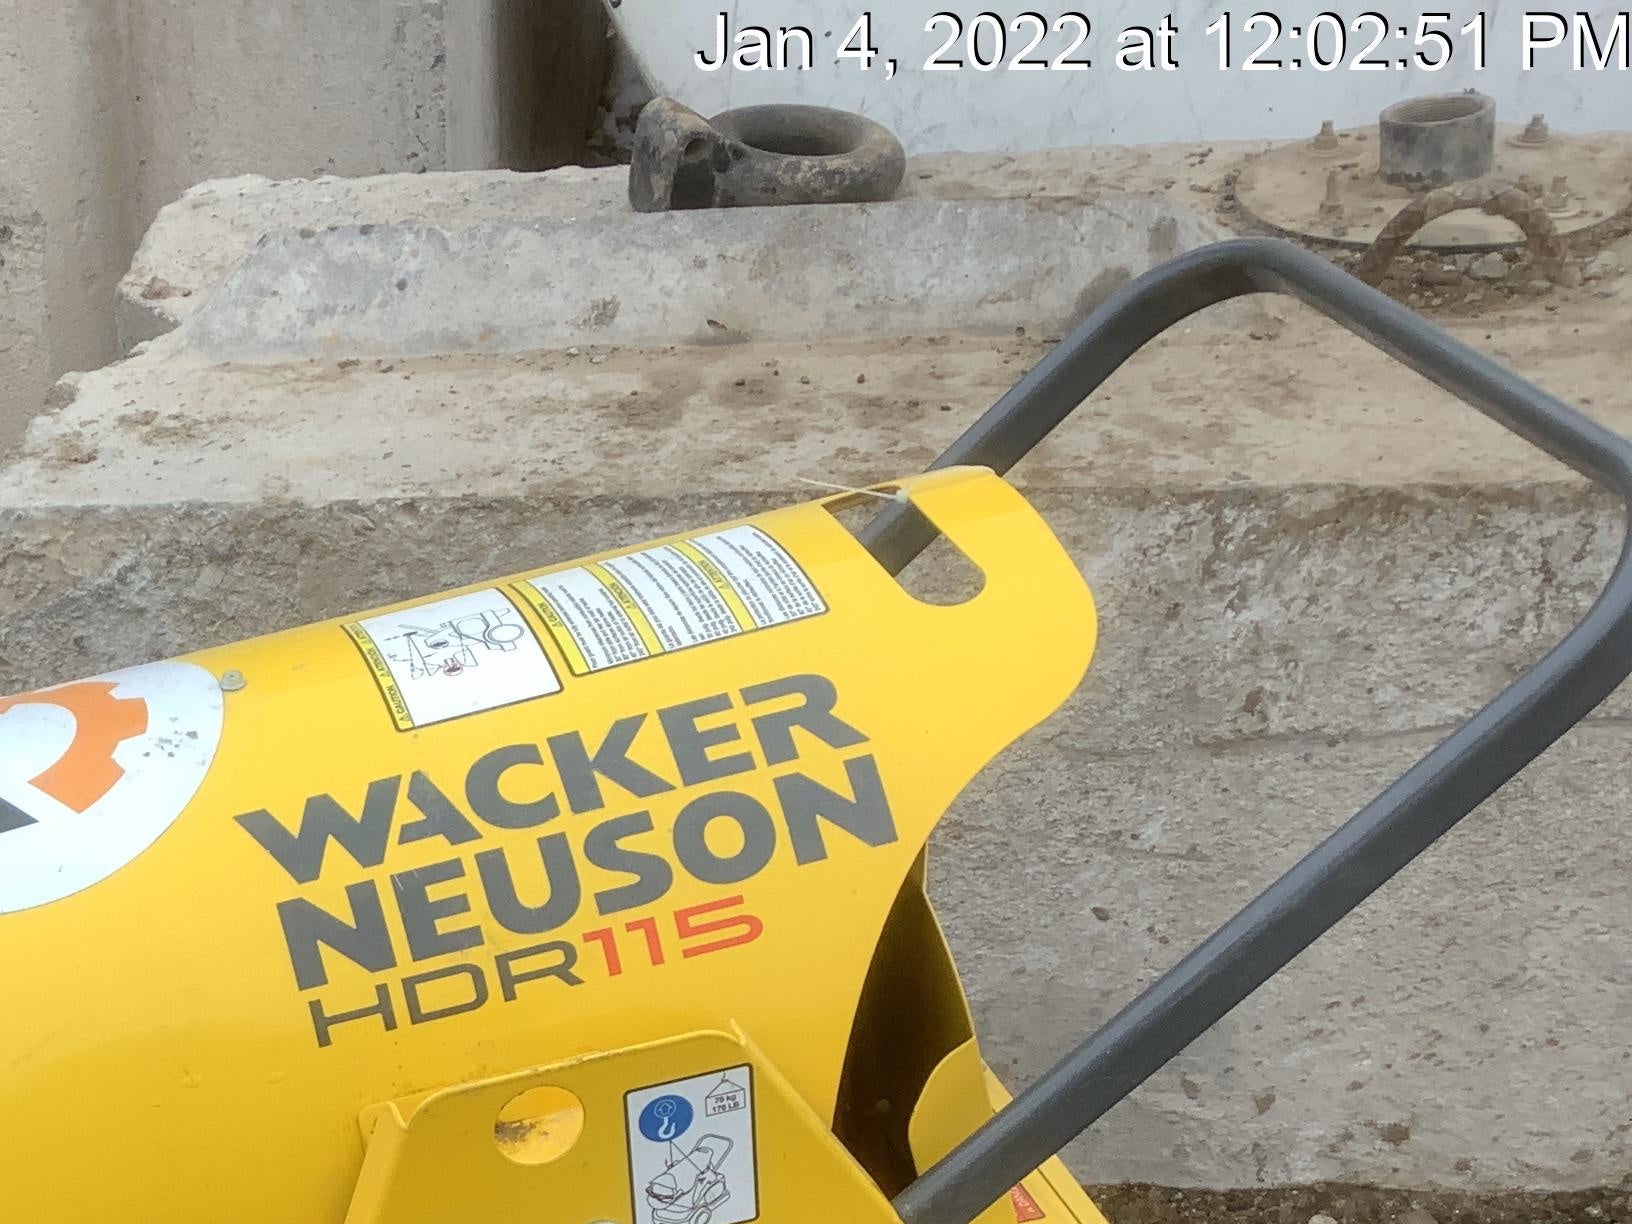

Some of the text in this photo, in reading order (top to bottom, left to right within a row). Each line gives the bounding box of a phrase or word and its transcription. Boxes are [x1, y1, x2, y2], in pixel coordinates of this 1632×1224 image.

[233, 674, 871, 884] WACKER
[386, 685, 405, 714] CAUTION
[276, 753, 899, 991] NEUSON
[308, 894, 765, 1049] HDR115
